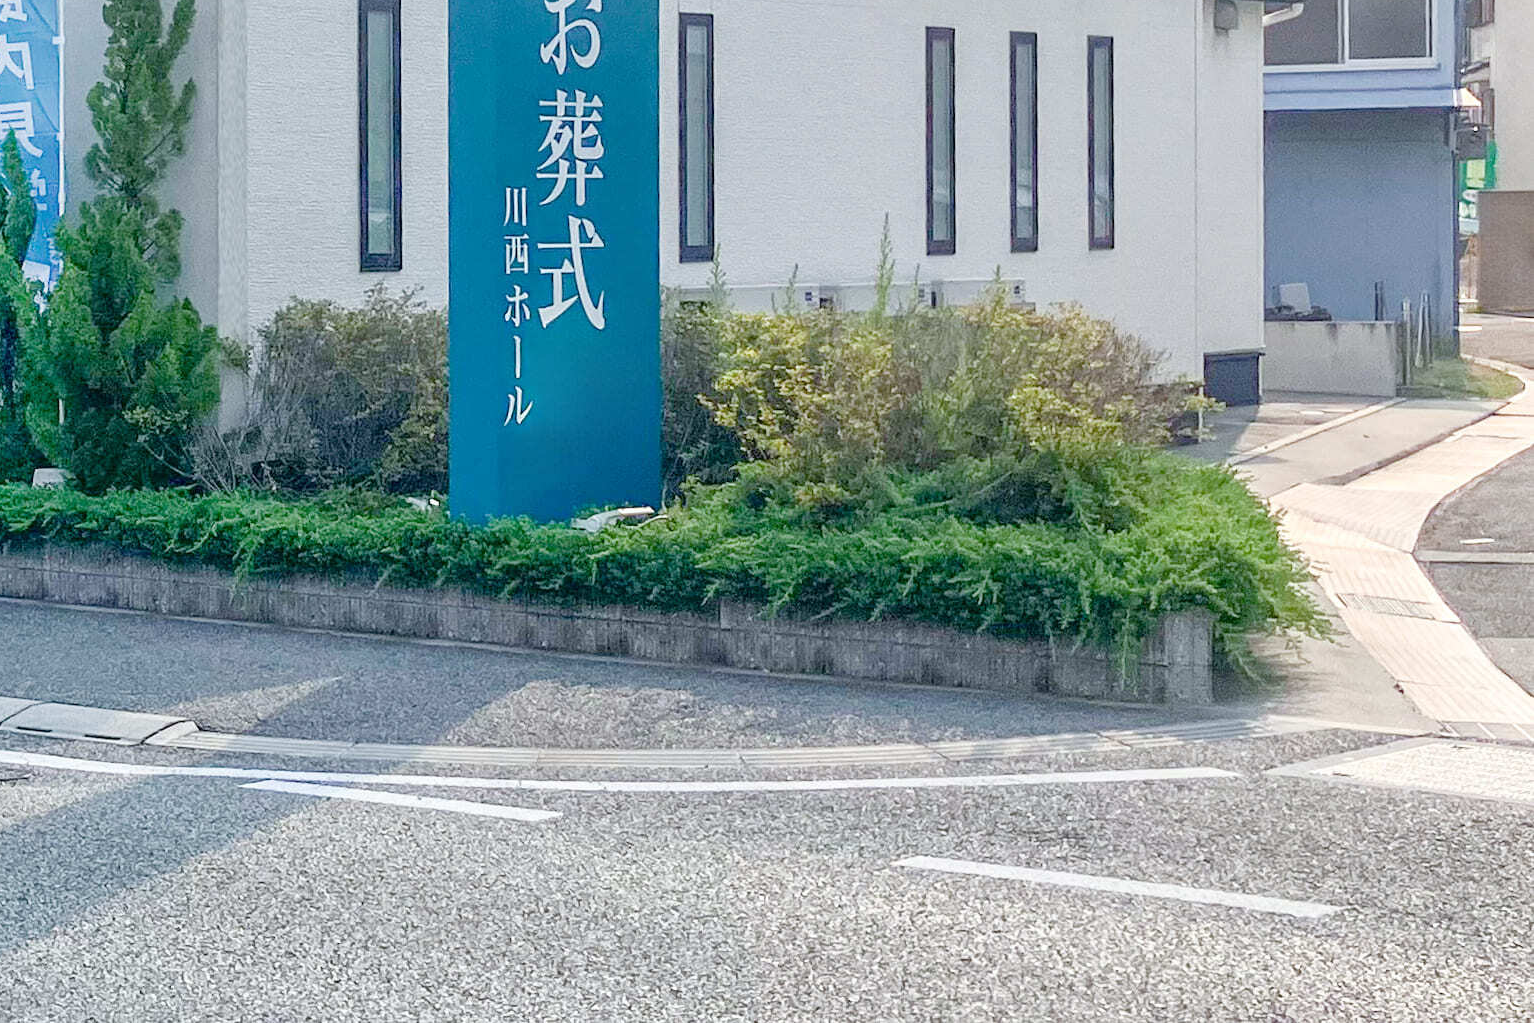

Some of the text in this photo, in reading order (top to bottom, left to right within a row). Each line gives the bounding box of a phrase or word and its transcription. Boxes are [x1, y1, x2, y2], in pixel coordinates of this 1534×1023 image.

[503, 186, 533, 428] 川西ホール
